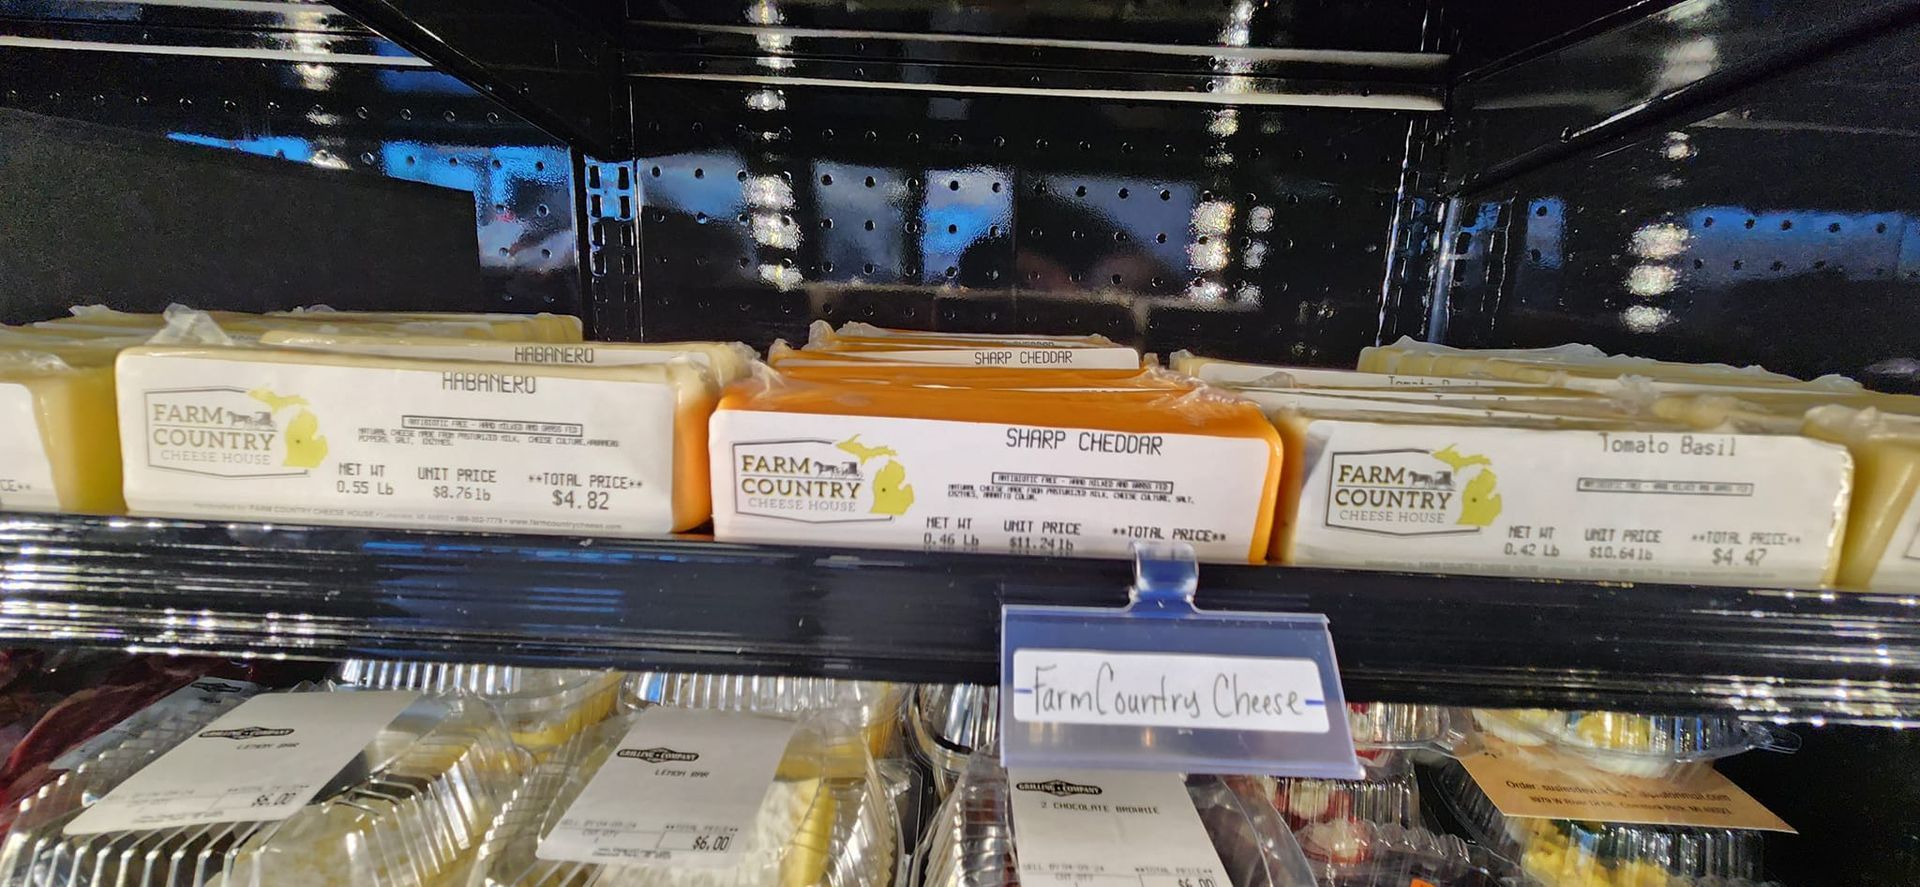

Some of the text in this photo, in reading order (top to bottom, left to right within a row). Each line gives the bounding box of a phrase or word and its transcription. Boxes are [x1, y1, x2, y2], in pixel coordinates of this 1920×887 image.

[514, 346, 594, 364] HABANERO
[974, 351, 1072, 365] SHARP CHEDDAR
[442, 371, 536, 394] HABANERO
[153, 404, 224, 424] FARM
[153, 428, 276, 451] COUNTRY
[1006, 428, 1163, 456] SHARP CHEDDAR
[1598, 432, 1736, 456] Tomato Basil
[161, 450, 271, 466] CHEESE HOUSE
[742, 454, 810, 474] FARM
[338, 462, 386, 478] NET WT
[418, 467, 498, 483] UNIT PRICE
[1338, 464, 1405, 484] FARM
[336, 480, 394, 496] 0.55 Lb
[741, 478, 861, 499] COUNTRY
[552, 490, 610, 510] $4.82
[749, 497, 856, 513] CHEESE HOUSE
[1335, 488, 1453, 510] COUNTRY
[926, 516, 972, 530] NET WT
[1340, 510, 1446, 524] CHEESE HOUSE
[1004, 520, 1081, 536] UNIT PRICE
[1509, 526, 1554, 540] NET WT
[1585, 528, 1662, 543] UNIT PRICE
[924, 532, 980, 547] 0.46 Lb
[1504, 542, 1560, 558] 0.42 Lb
[1712, 549, 1768, 566] $4.47
[1213, 673, 1304, 718] Cheese
[1063, 784, 1100, 794] COMPANY
[1053, 802, 1110, 812] CHOCOLATE
[693, 835, 730, 852] $6.00
